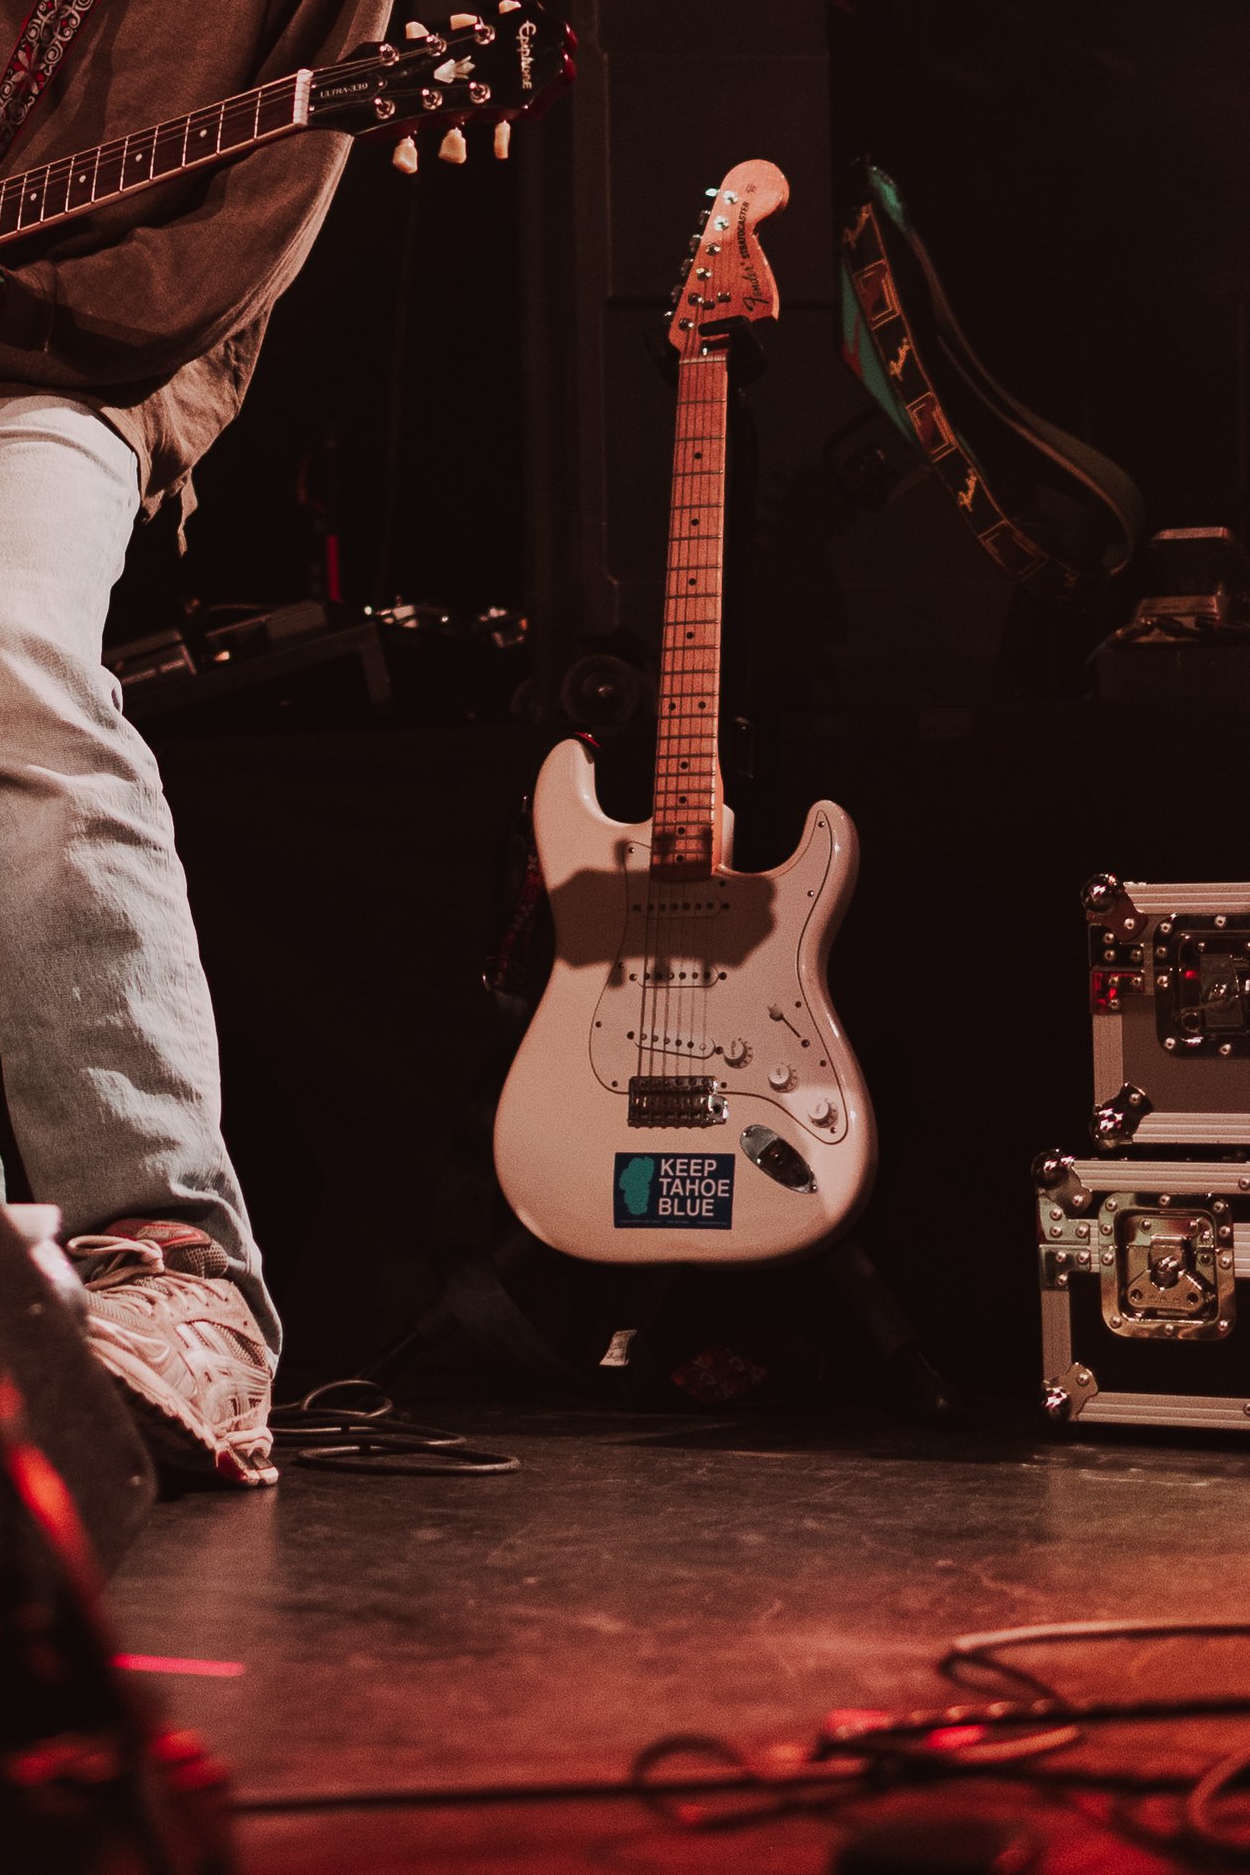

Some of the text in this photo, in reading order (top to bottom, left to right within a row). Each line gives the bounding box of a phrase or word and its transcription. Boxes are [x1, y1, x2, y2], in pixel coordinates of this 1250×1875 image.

[515, 20, 537, 90] Epiphone
[737, 201, 769, 311] Fender STRATOCASTER
[660, 1158, 717, 1177] KEEP
[658, 1178, 730, 1197] TAHOE
[658, 1198, 715, 1217] BLUE
